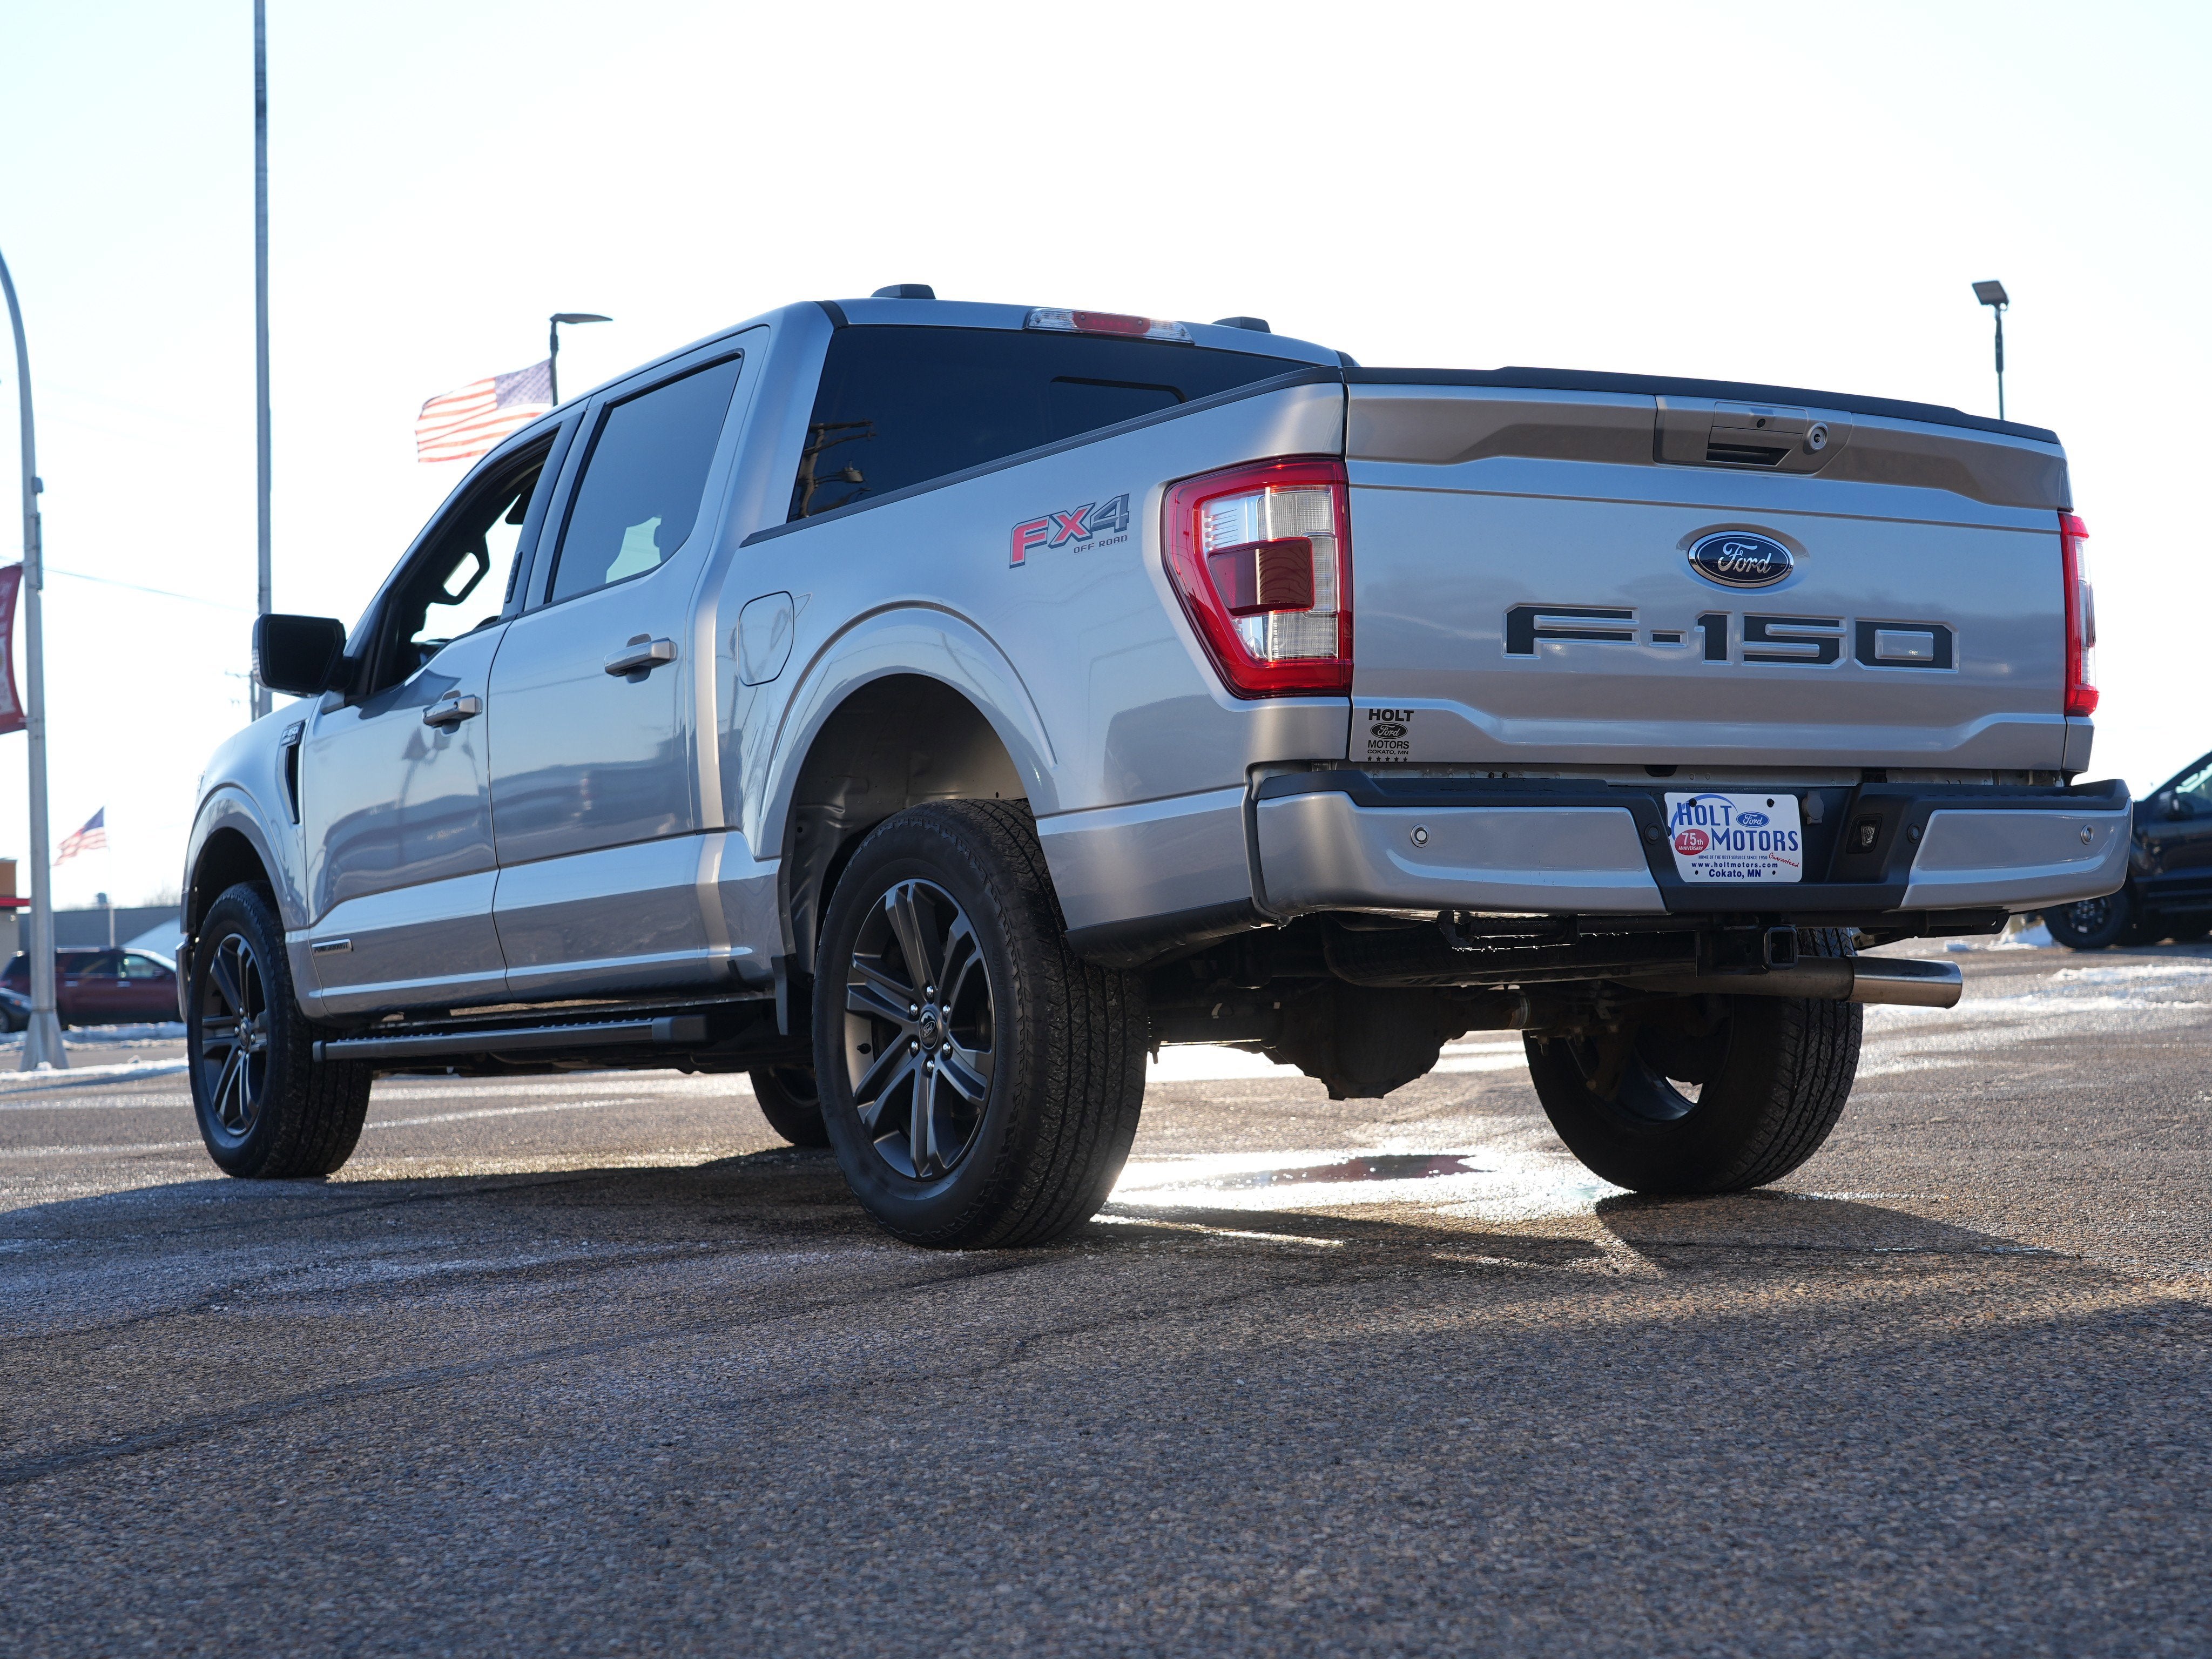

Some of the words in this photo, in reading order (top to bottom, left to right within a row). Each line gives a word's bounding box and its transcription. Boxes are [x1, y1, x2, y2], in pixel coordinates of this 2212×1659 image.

[1009, 493, 1130, 569] FX4
[1074, 543, 1095, 554] OFF
[1098, 535, 1128, 548] ROAD
[1717, 542, 1772, 574] Ford
[1505, 604, 1958, 672] F-150
[1368, 709, 1414, 721] HOLT
[1377, 724, 1401, 737] Ford
[1367, 740, 1410, 749] MOTORS
[1677, 802, 1732, 826] HOLT
[1743, 813, 1763, 825] Ford
[1682, 832, 1703, 846] 75th
[1711, 827, 1798, 851] MOTORS
[1769, 852, 1799, 867] Guaranteed
[1709, 868, 1744, 879] Cokato,
[1748, 869, 1761, 878] MN
